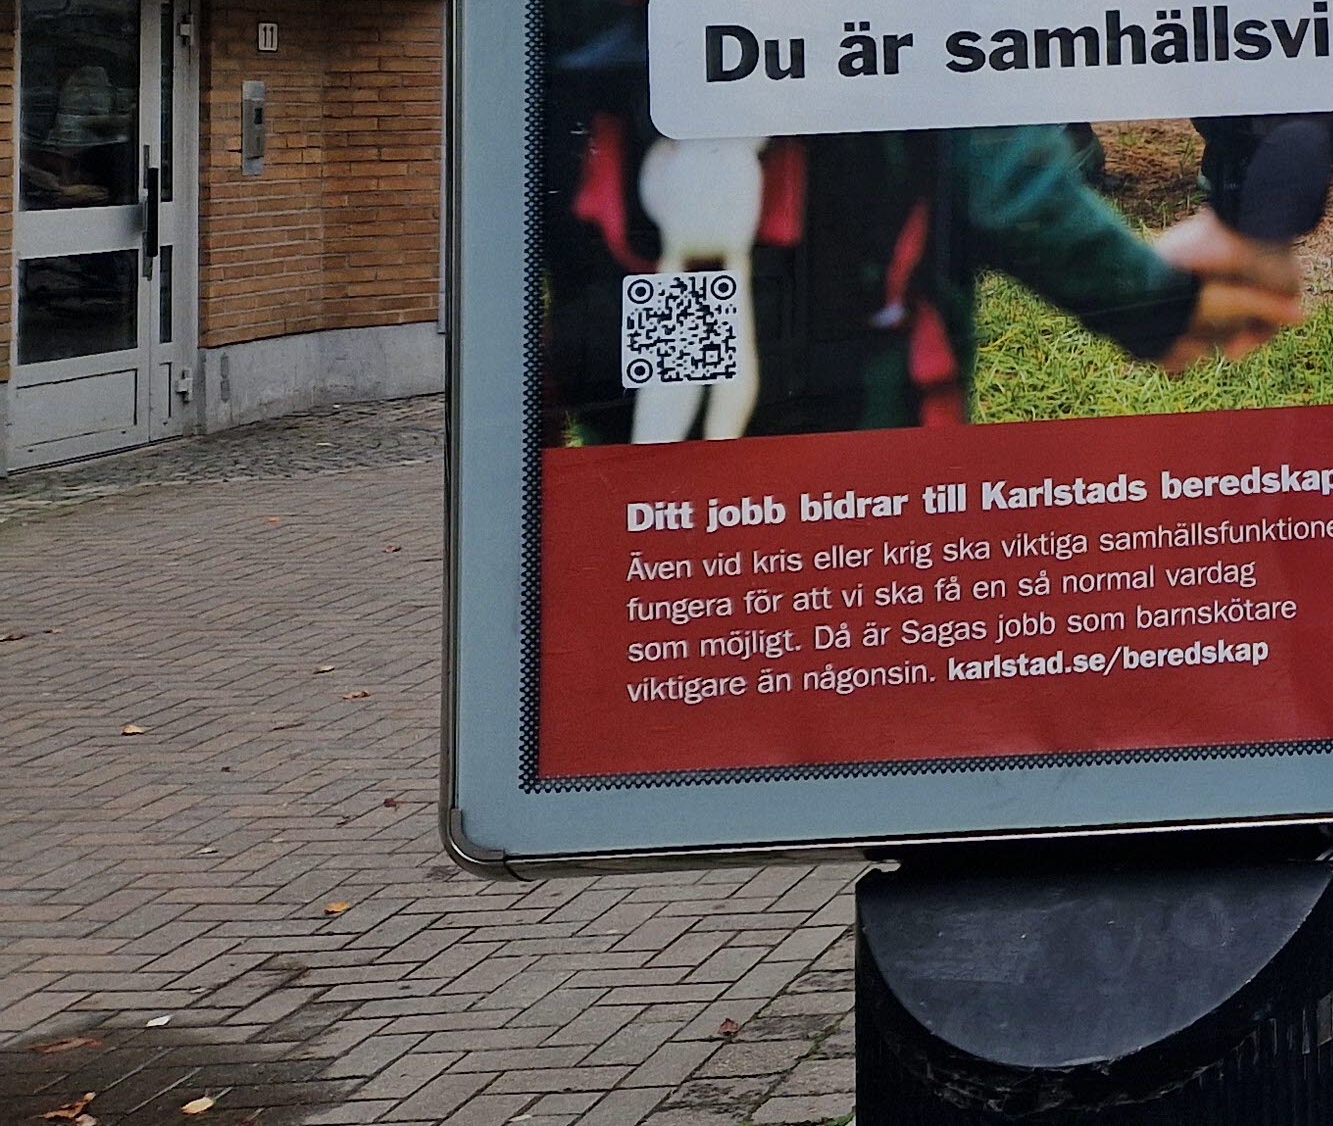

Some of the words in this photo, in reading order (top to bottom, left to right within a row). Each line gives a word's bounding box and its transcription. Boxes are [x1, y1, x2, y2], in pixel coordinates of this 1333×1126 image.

[262, 25, 274, 48] 11
[704, 23, 807, 83] Du
[837, 20, 915, 78] är
[627, 501, 695, 532] Ditt
[706, 495, 787, 533] jobb
[800, 490, 909, 522] bidrar
[922, 482, 967, 514] till
[981, 473, 1148, 511] Karlstads
[626, 551, 692, 582] Även
[702, 551, 741, 577] vid
[753, 548, 803, 574] kris
[813, 544, 874, 570] eller
[883, 539, 933, 569] krig
[942, 536, 990, 562] ska
[1001, 531, 1088, 560] viktiga
[626, 597, 733, 625] fungera
[743, 588, 784, 614] för
[792, 586, 833, 611] att
[841, 583, 863, 608] vi
[875, 581, 923, 606] ska
[934, 575, 961, 602] få
[972, 579, 1006, 600] en
[1018, 569, 1050, 597] så
[1062, 564, 1155, 594] normal
[1165, 560, 1257, 588] vardag
[628, 640, 688, 662] som
[700, 629, 801, 660] möjligt.
[815, 622, 851, 650] Då
[862, 621, 892, 647] är
[901, 619, 987, 648] Sagas
[994, 611, 1056, 644] jobb
[1067, 611, 1125, 633] som
[1136, 597, 1297, 629] barnskötare
[626, 675, 747, 705] viktigare
[757, 668, 792, 694] än
[803, 660, 936, 695] någonsin.
[948, 639, 1269, 681] karlstad.se/beredskap
